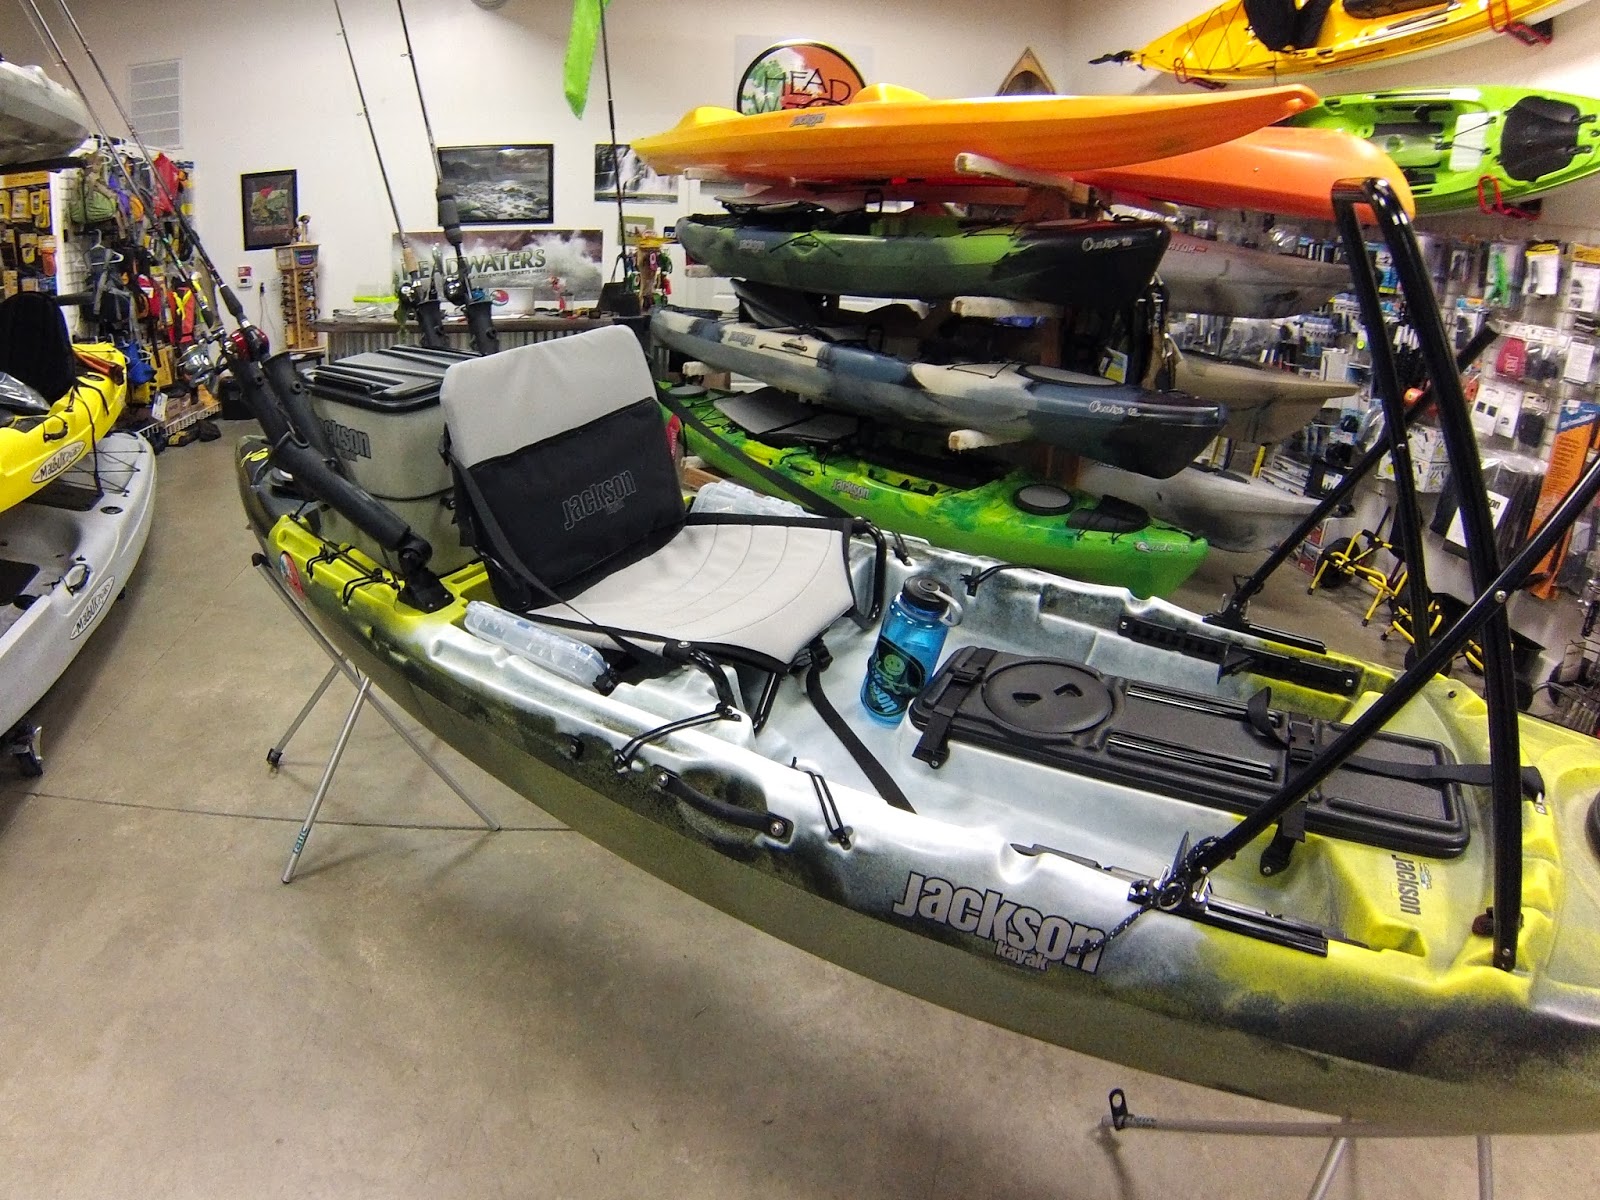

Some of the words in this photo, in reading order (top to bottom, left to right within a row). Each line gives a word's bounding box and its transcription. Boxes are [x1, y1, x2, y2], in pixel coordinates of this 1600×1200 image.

[764, 68, 851, 103] HEAD
[324, 420, 371, 459] ckson
[892, 871, 1106, 974] Jackson
[995, 940, 1050, 971] kayak
